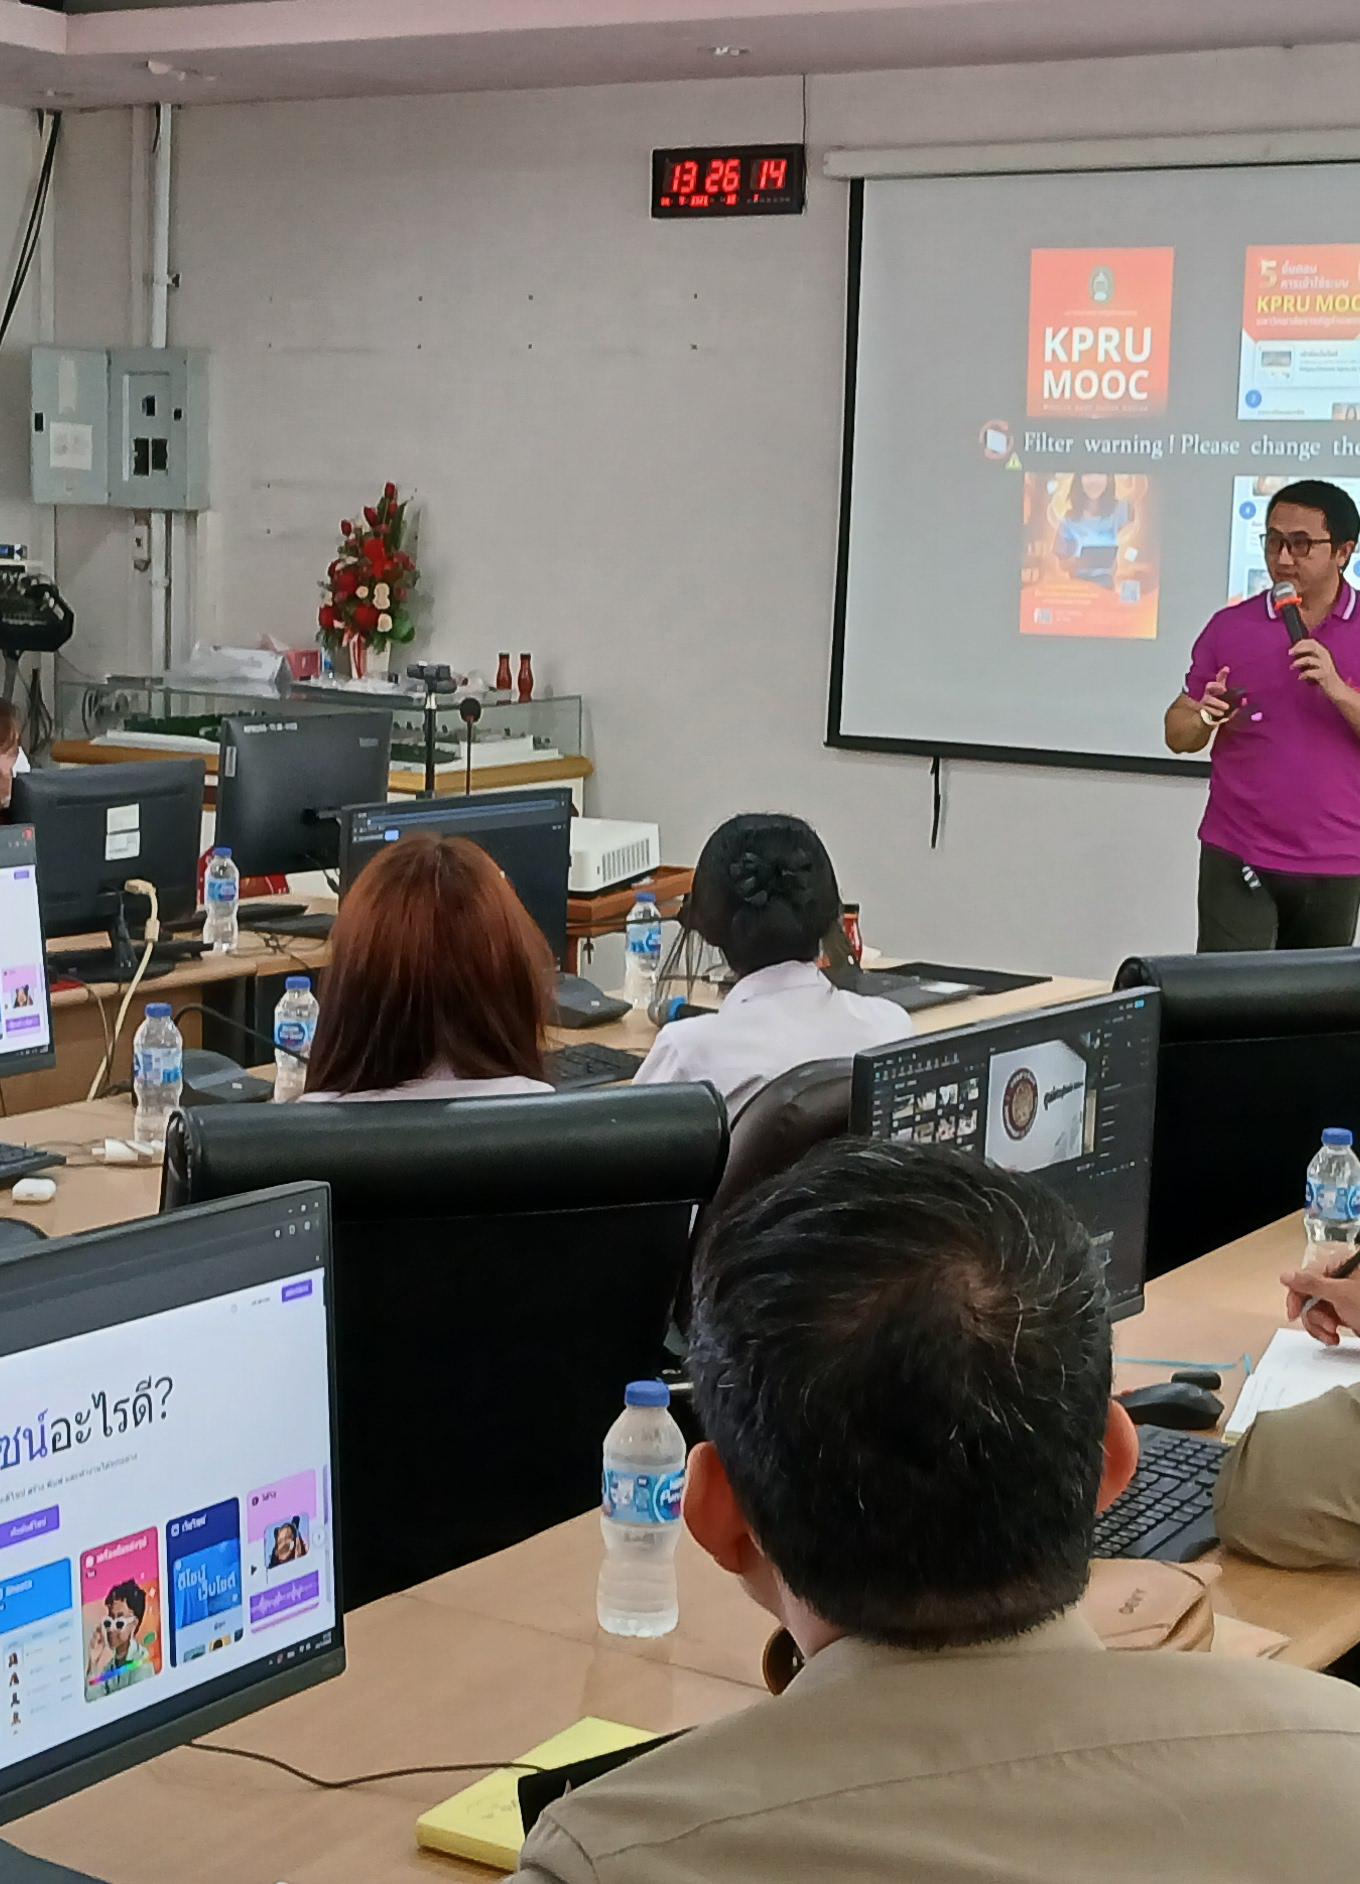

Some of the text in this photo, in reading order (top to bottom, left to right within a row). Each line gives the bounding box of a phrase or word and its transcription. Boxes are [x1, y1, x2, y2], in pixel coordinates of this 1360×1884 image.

[671, 158, 788, 194] 13 26 14
[1258, 259, 1278, 288] 5
[1256, 294, 1311, 314] KPRU
[1043, 326, 1152, 363] KPRU
[1042, 368, 1150, 401] MOOC
[1023, 431, 1074, 454] Filter
[1181, 433, 1240, 456] Please
[1251, 435, 1321, 461] change
